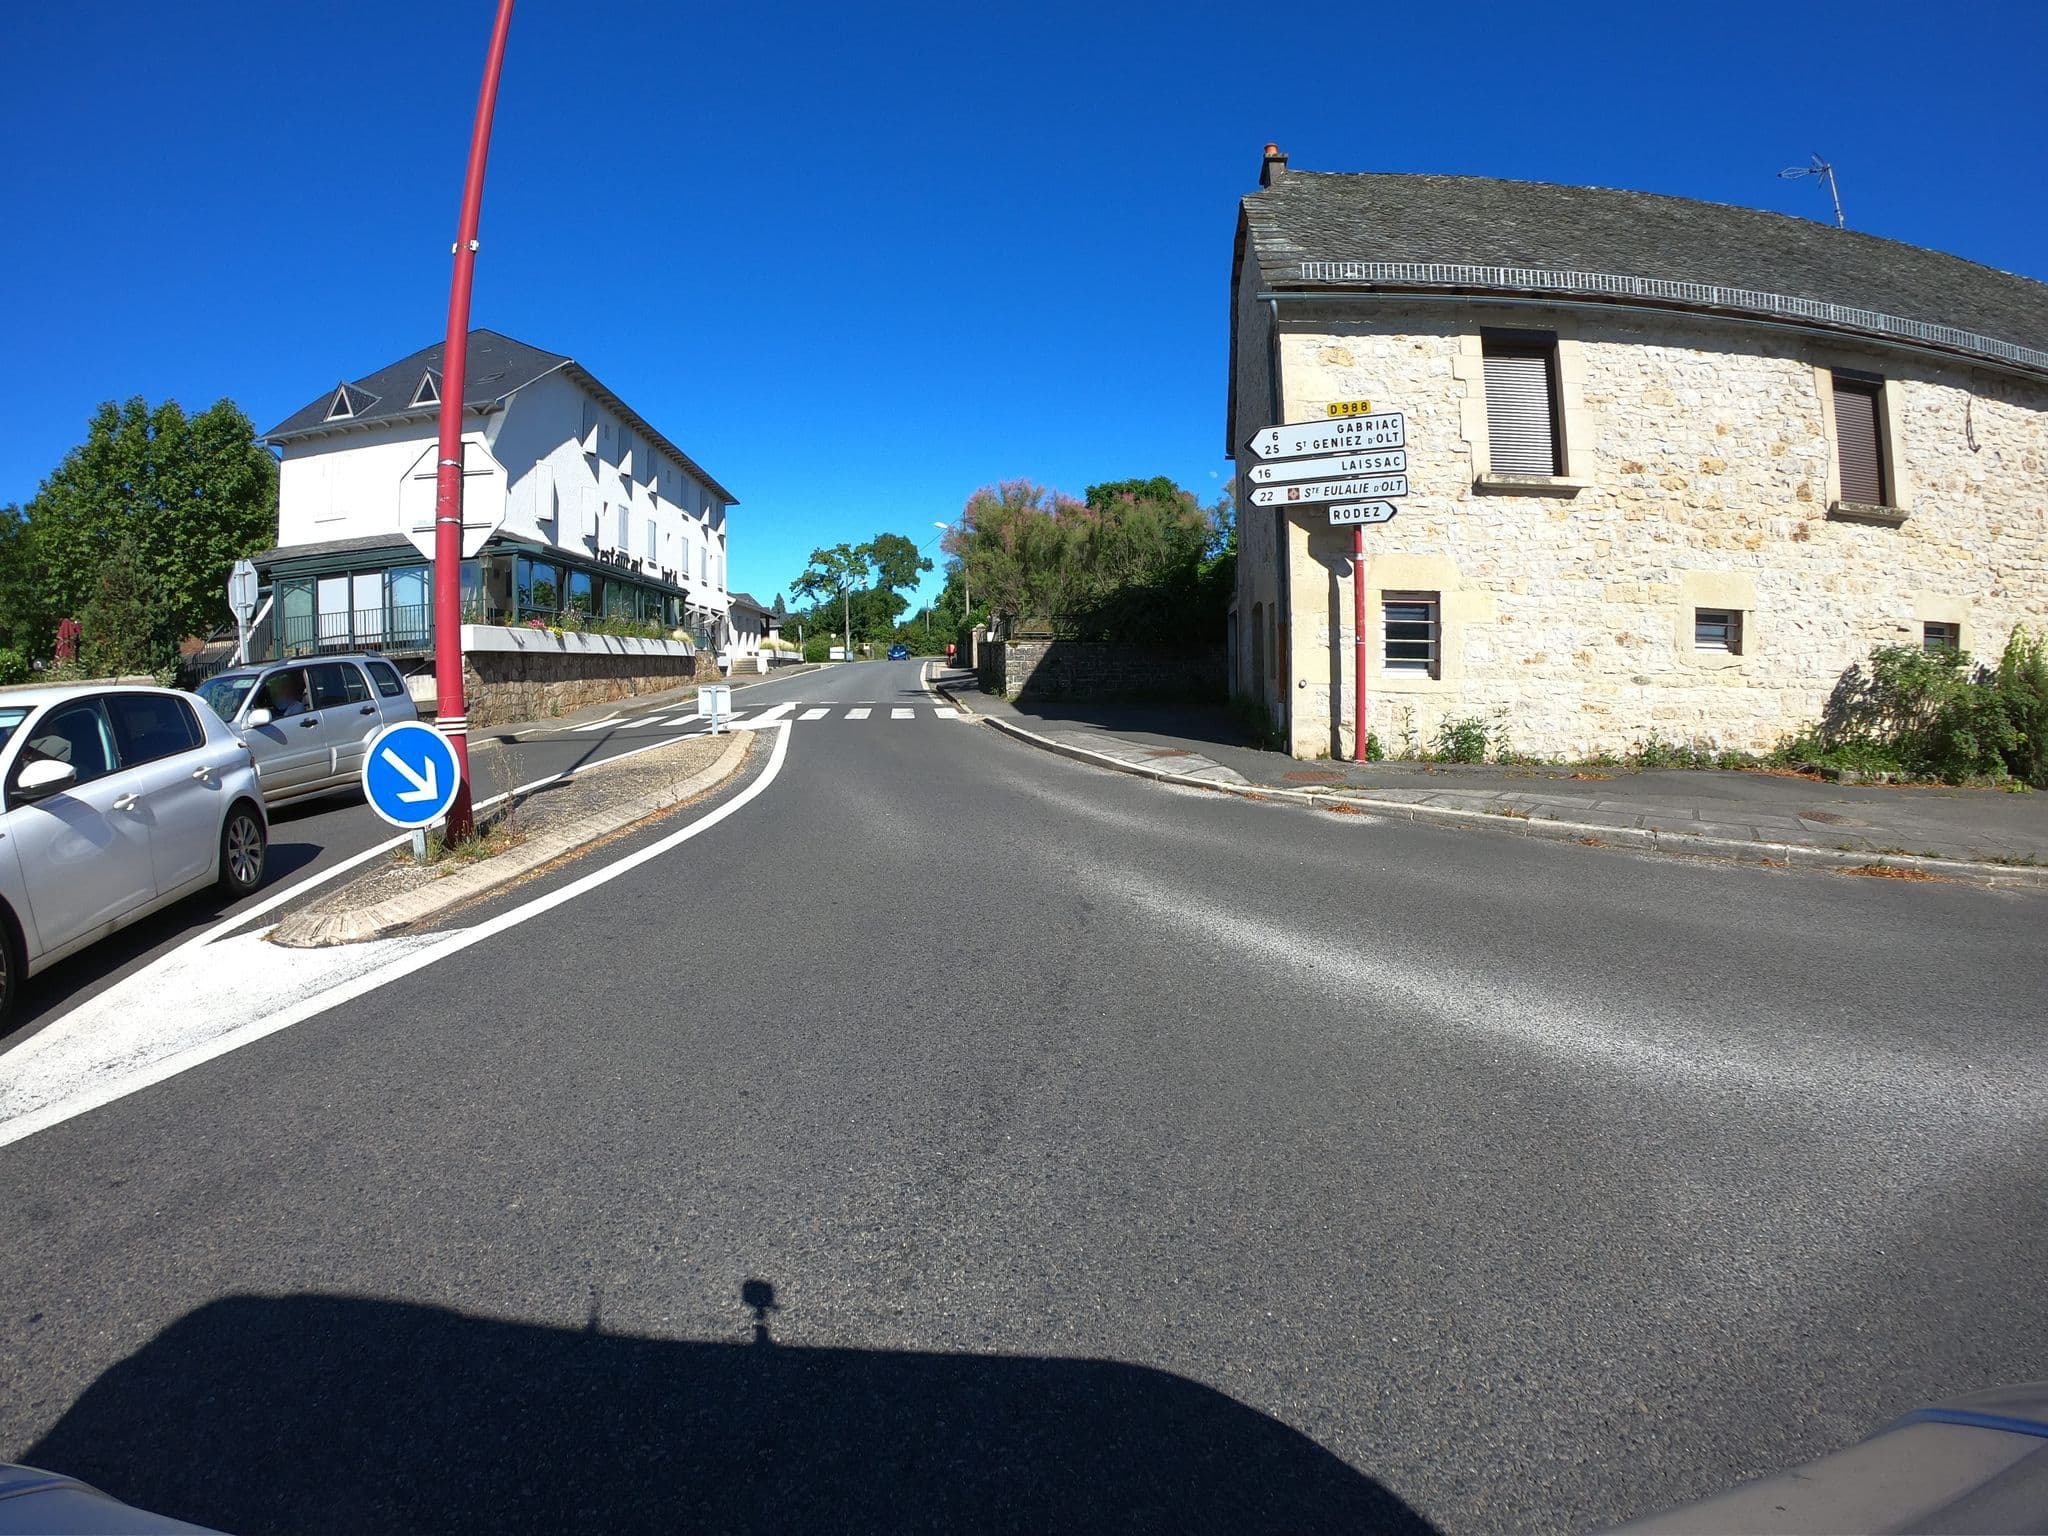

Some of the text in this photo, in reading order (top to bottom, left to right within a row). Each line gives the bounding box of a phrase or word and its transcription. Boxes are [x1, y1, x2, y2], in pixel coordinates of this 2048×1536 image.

[1329, 402, 1368, 415] D 988
[1272, 419, 1399, 441] 6 GABRIAC
[1265, 444, 1280, 455] 25
[1313, 436, 1362, 450] GENIEZ
[1258, 456, 1401, 479] 16 LAISSAC
[1259, 491, 1274, 502] 22
[1323, 483, 1369, 497] EULALIE
[1333, 507, 1381, 520] RODEZ
